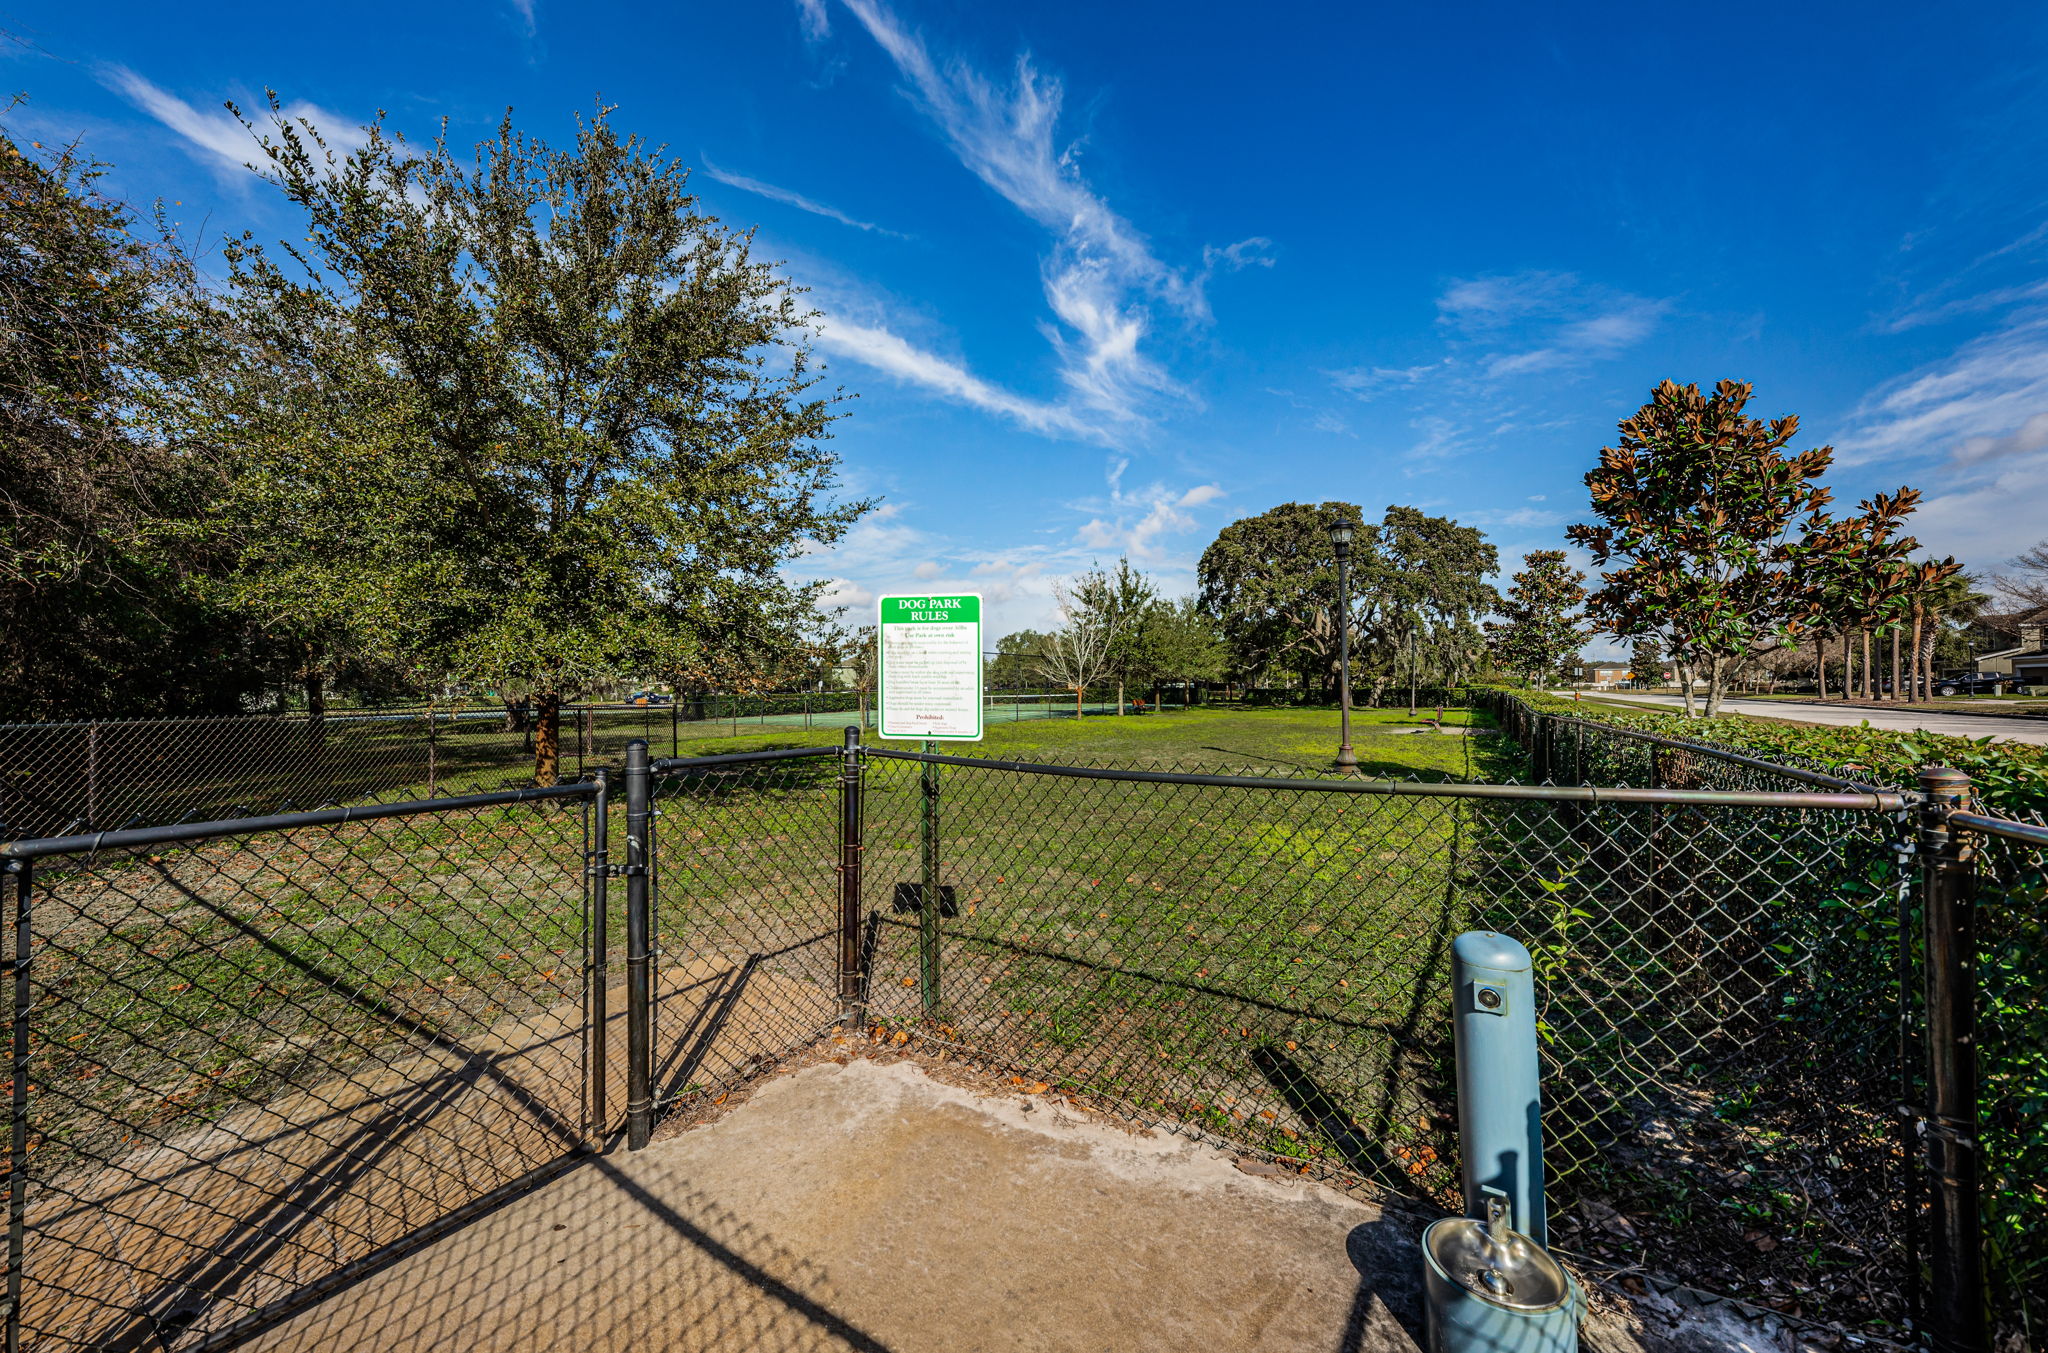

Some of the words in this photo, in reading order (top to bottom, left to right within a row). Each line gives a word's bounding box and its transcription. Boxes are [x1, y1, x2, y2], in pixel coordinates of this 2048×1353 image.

[898, 600, 926, 609] DOG
[929, 598, 962, 609] PARK
[911, 610, 949, 620] RULES
